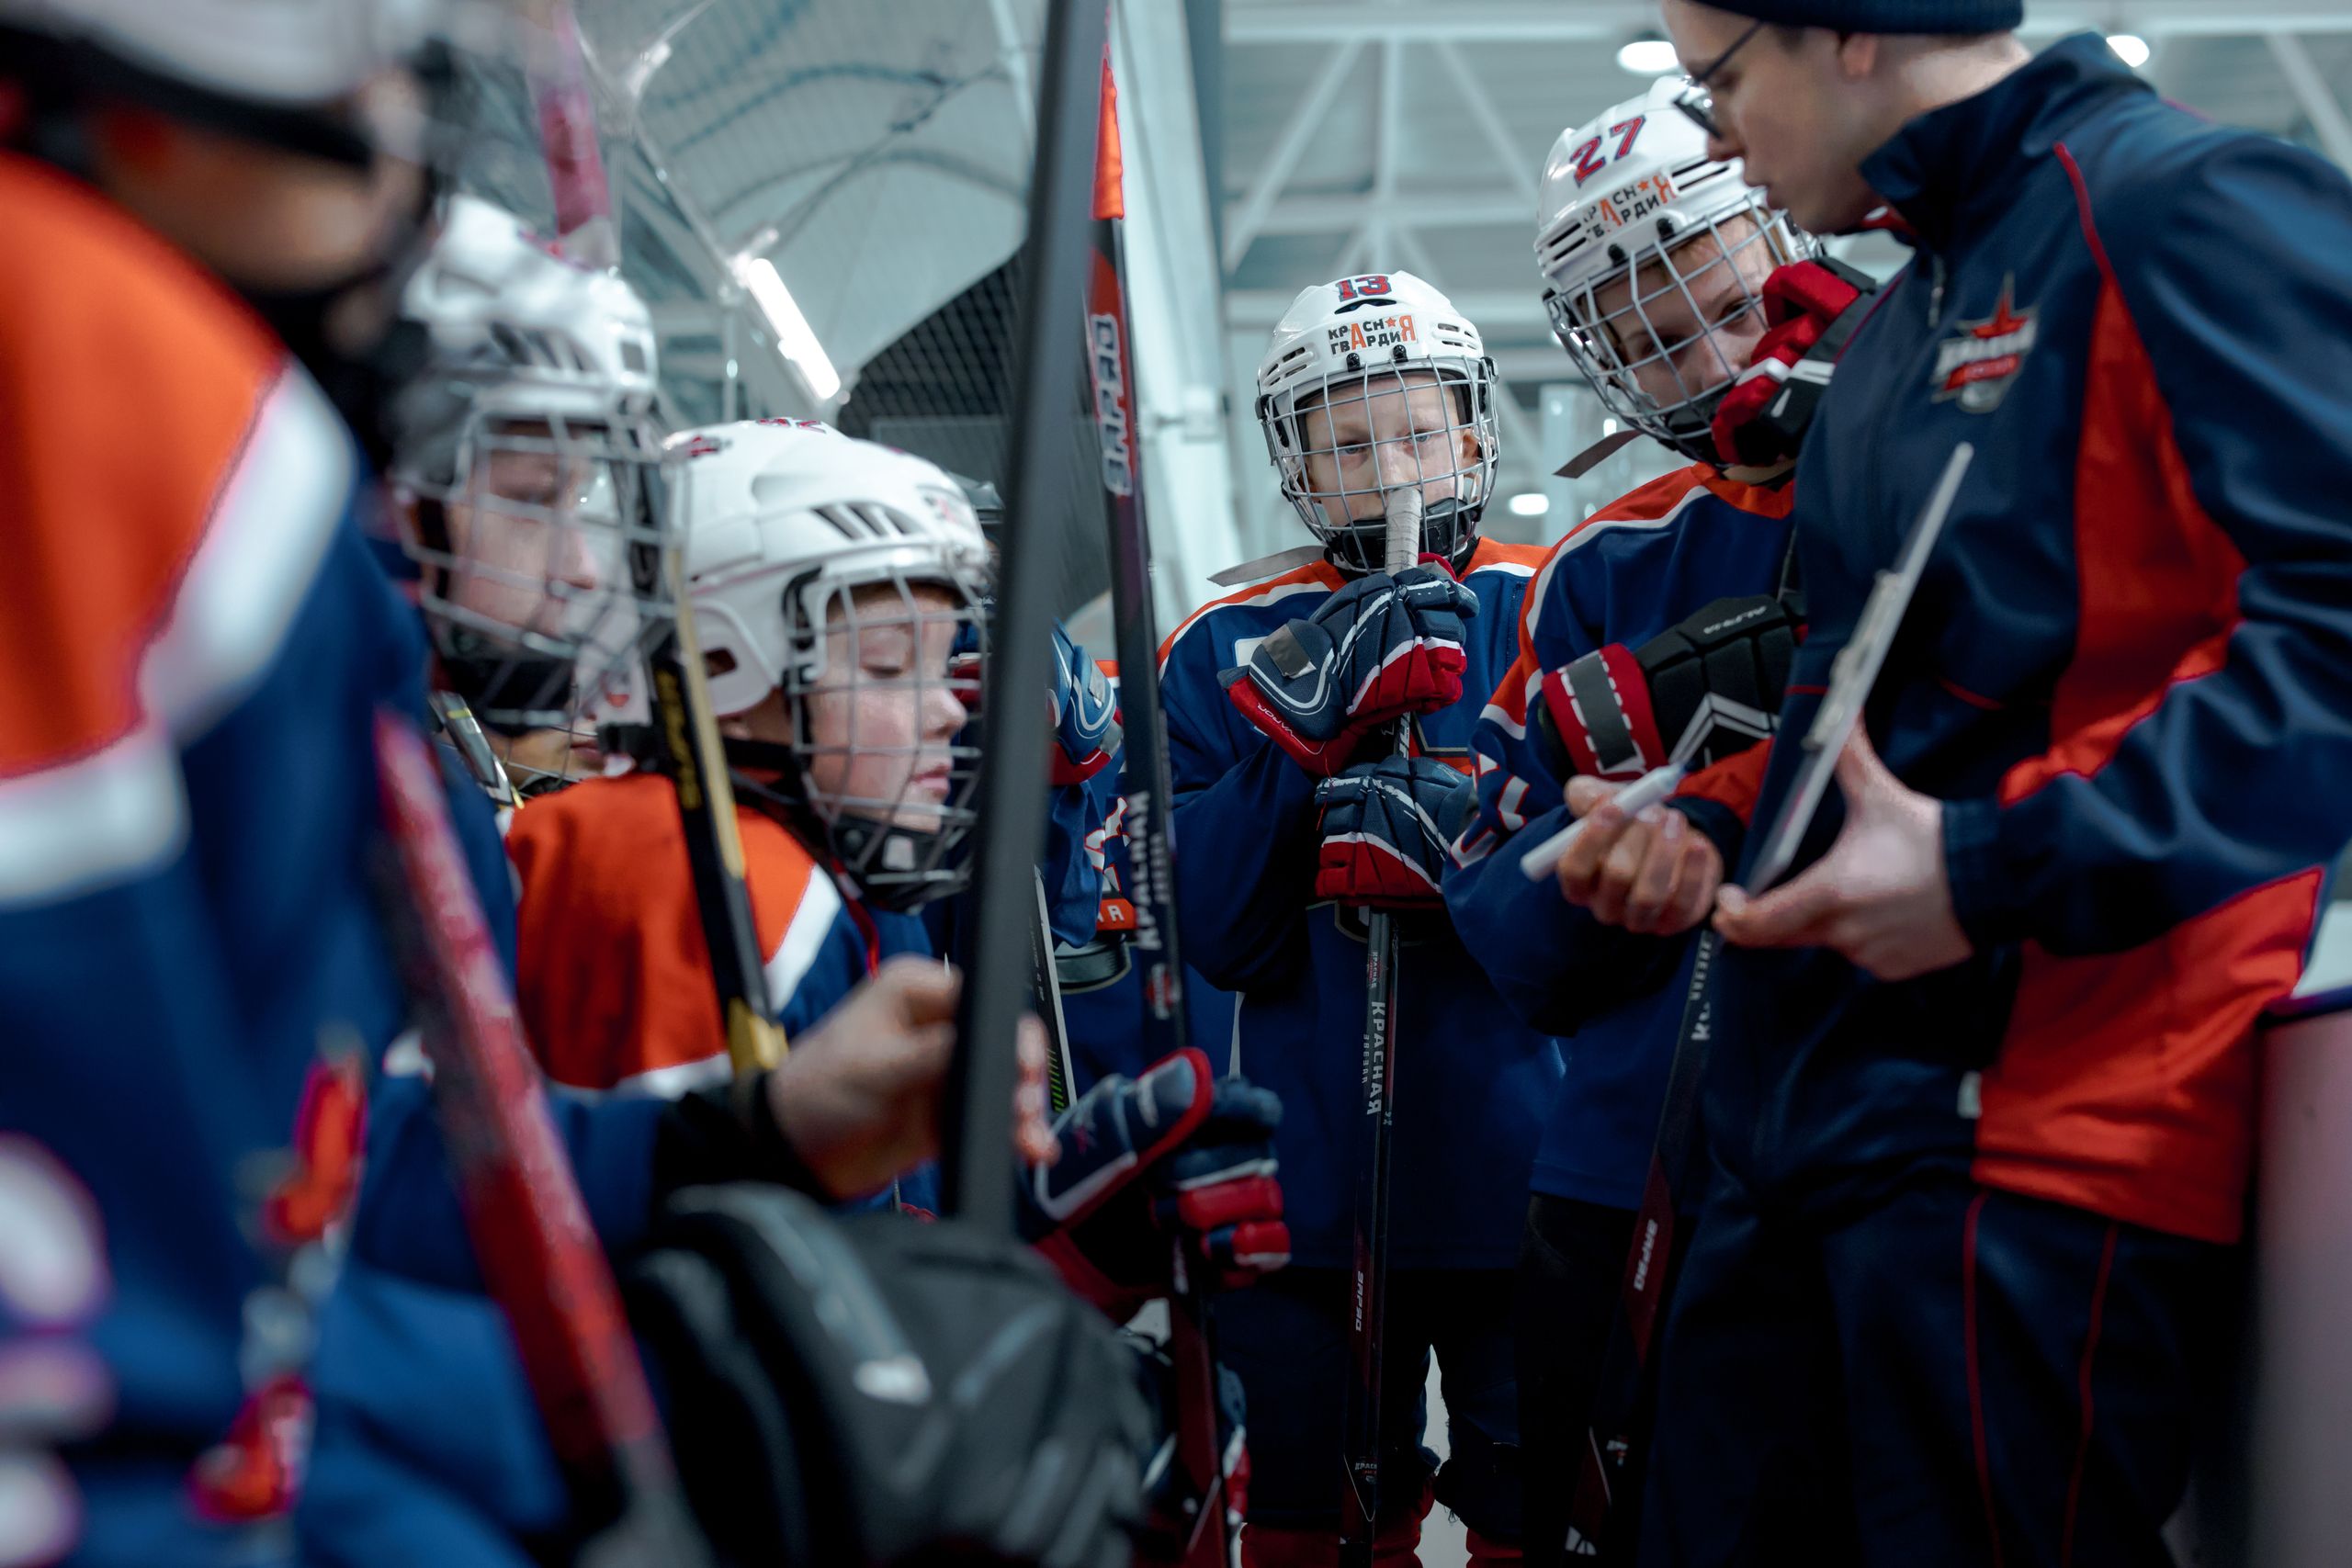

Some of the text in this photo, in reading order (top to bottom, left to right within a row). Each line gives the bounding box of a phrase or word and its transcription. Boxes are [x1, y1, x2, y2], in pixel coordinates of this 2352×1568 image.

[1569, 115, 1646, 188] 27
[1335, 275, 1392, 303] 13
[1257, 702, 1294, 737] VAPOR
[1366, 1001, 1386, 1115] КРАСНАЯ
